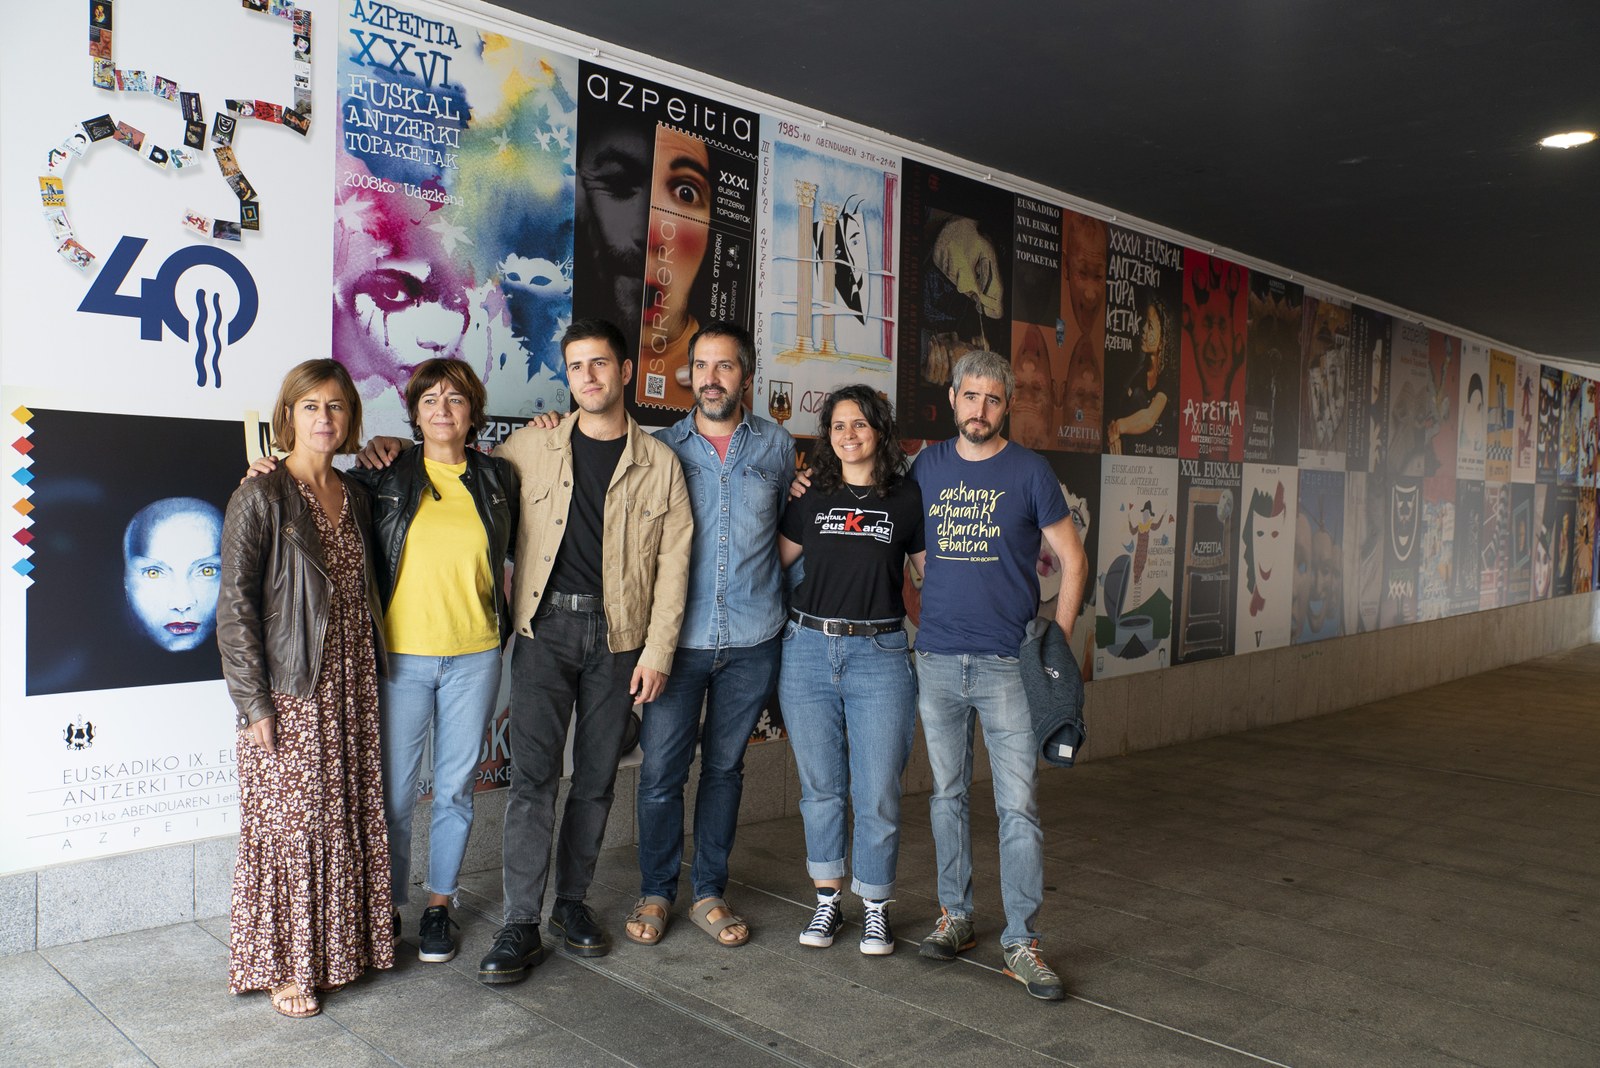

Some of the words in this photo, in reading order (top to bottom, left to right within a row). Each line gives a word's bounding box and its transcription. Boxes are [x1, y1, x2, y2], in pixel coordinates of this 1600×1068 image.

[349, 0, 462, 49] AZPEITIA
[349, 29, 459, 90] XXVI.
[347, 74, 460, 121] EUSKAL
[346, 105, 461, 149] ANTZERKI
[345, 132, 459, 170] TOPAKETAK
[816, 137, 857, 156] ABENDUAREN
[343, 172, 396, 193] 2008ko
[404, 183, 465, 207] Udazkena
[719, 170, 750, 190] XXXI.
[760, 157, 769, 214] EUSKAL
[1017, 197, 1060, 219] EUSKADIKO
[1016, 234, 1059, 252] ANTZERKI
[1032, 220, 1060, 236] EUSKAL
[758, 228, 768, 298] ANTZERKI
[1015, 250, 1058, 269] TOPAKETAK
[1145, 236, 1183, 272] EUSKAL
[1108, 254, 1161, 288] ANTZERKI
[77, 235, 259, 346] 40
[1106, 280, 1136, 310] TOPA
[1106, 304, 1142, 336] KETAK
[1182, 398, 1242, 426] AZPEITIA
[1057, 425, 1101, 441] AZPEITIA
[1208, 423, 1233, 437] EUSKAL
[1180, 459, 1201, 476] XXI.
[1204, 461, 1240, 479] EUSKAL
[929, 500, 990, 524] euskaratik
[940, 480, 1005, 513] euskaraz
[937, 516, 1000, 538] elkarrekin
[1193, 541, 1222, 553] AZPEITIA
[63, 755, 180, 785] EUSKADIKO
[189, 752, 209, 767] IX.
[62, 777, 167, 807] ANTZERKI
[177, 768, 238, 789] TOPAK
[64, 810, 116, 827] 1991ko
[121, 795, 210, 819] ABENDUAREN
